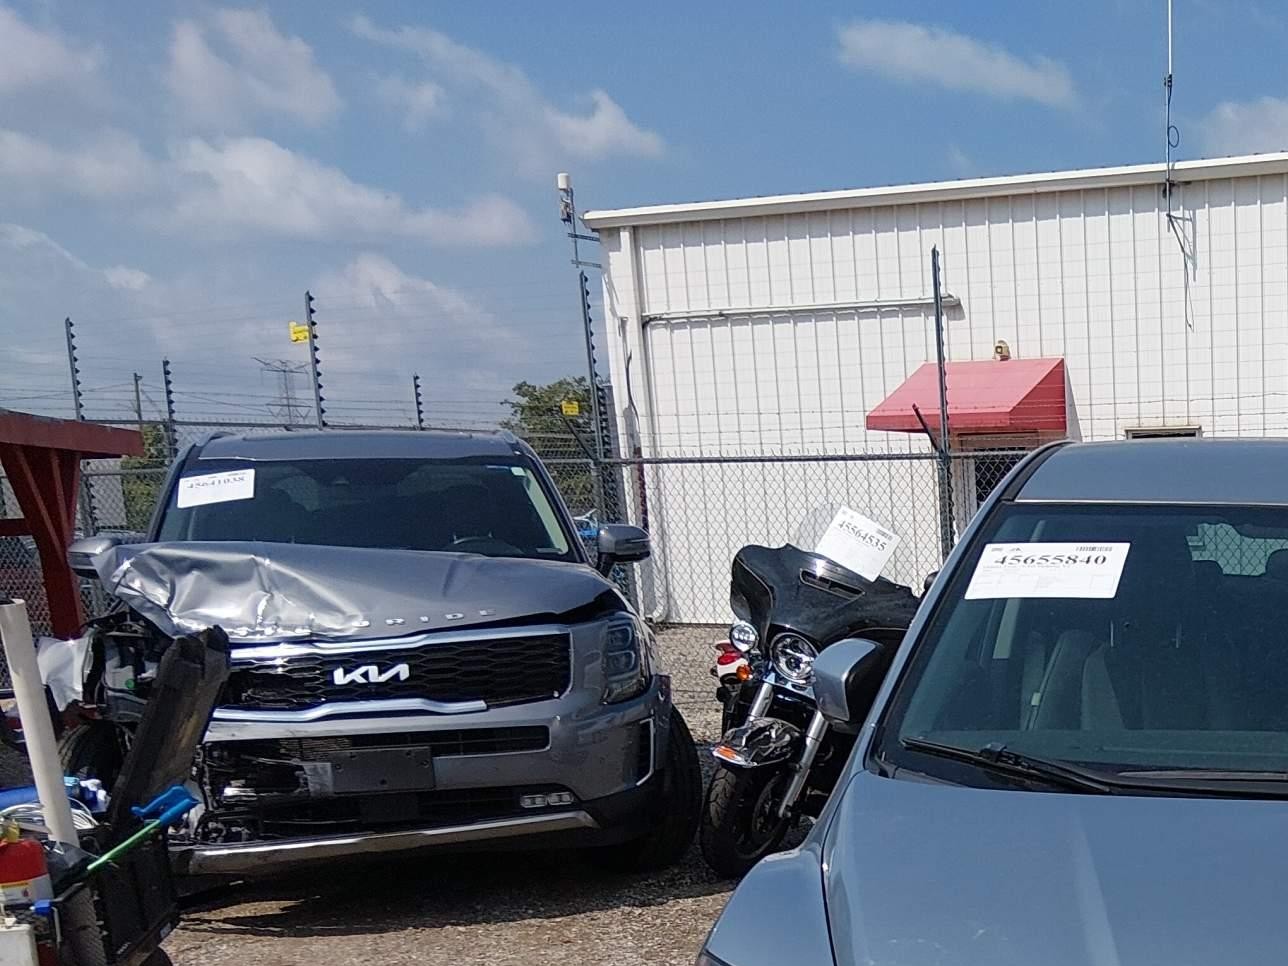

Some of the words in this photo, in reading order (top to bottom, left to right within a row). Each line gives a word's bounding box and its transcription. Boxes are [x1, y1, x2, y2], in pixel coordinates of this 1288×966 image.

[838, 520, 887, 552] 45564535
[994, 554, 1107, 566] 45655840
[332, 663, 410, 685] KIA
